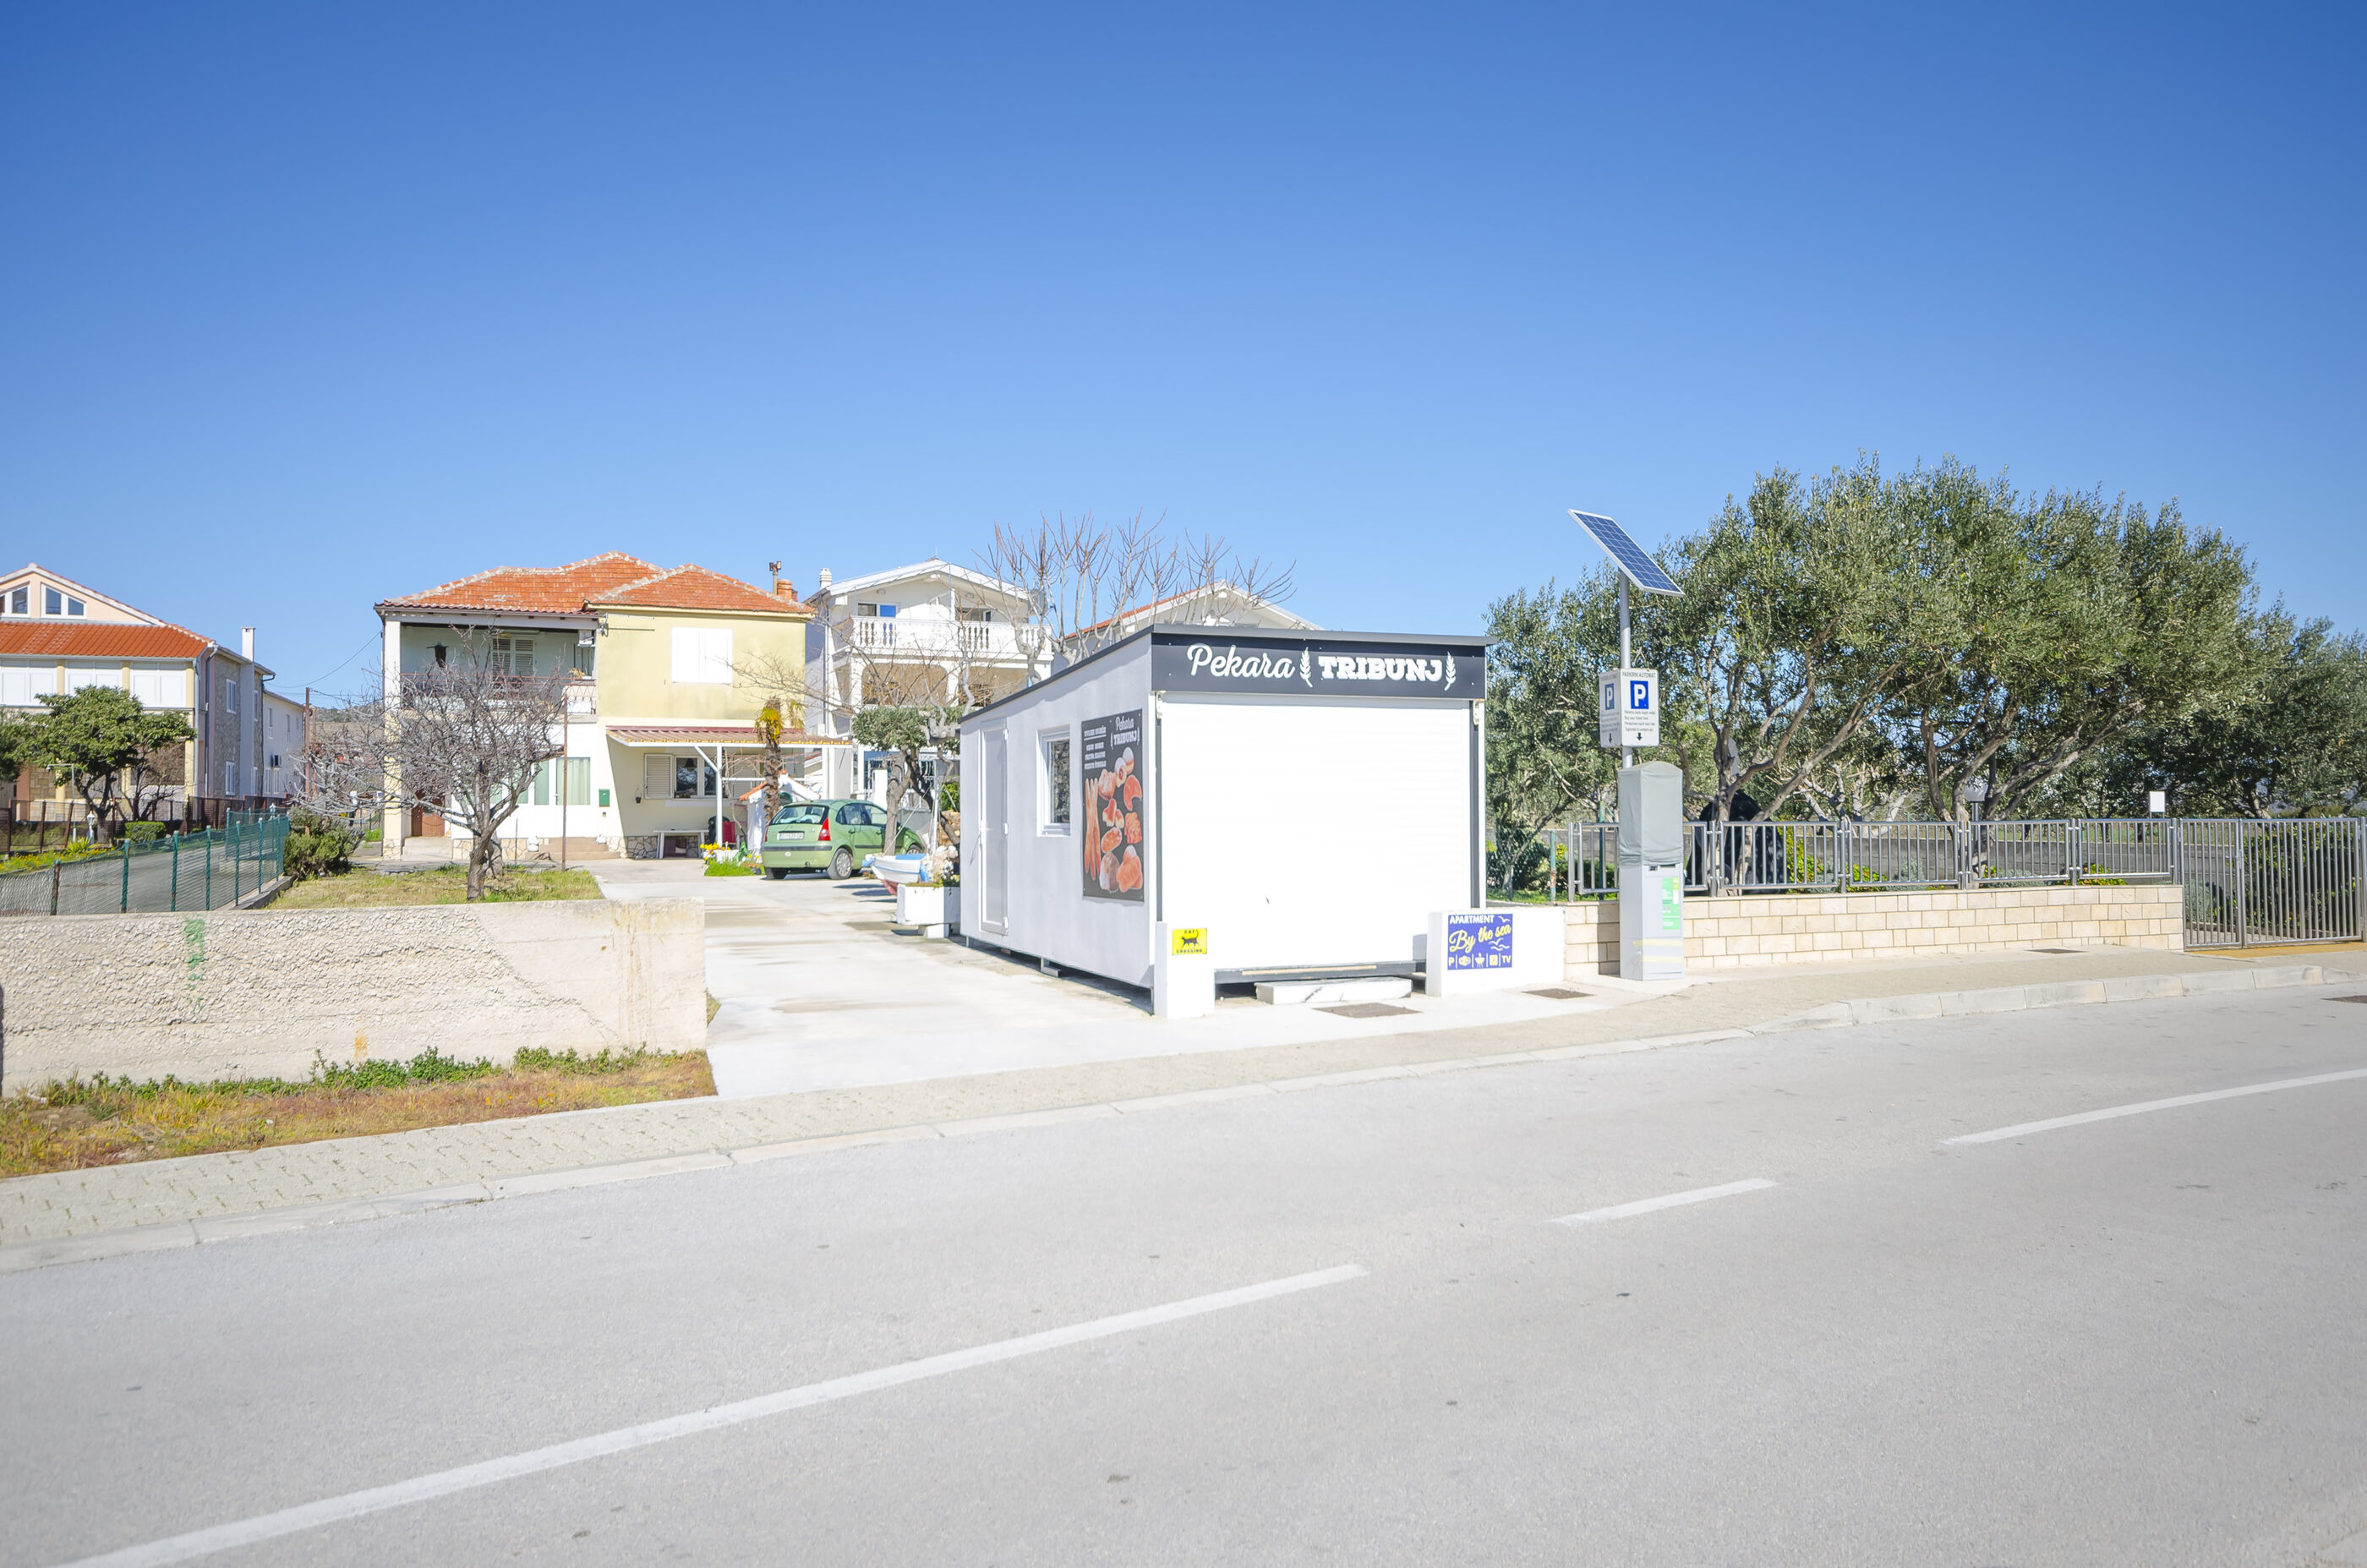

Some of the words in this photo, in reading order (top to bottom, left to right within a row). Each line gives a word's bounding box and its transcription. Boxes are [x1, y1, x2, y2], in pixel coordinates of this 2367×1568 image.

[1187, 643, 1295, 678] Pekara
[1318, 655, 1443, 682] TRIBUNJ
[1606, 686, 1614, 708] P
[1633, 684, 1647, 707] P
[1113, 729, 1137, 746] TRIBUNJ
[1449, 915, 1495, 925] APARTMENT
[1448, 929, 1476, 953] By
[1478, 926, 1493, 942] the
[1495, 924, 1511, 938] sea
[1448, 957, 1455, 966] P
[1501, 954, 1511, 964] TV
